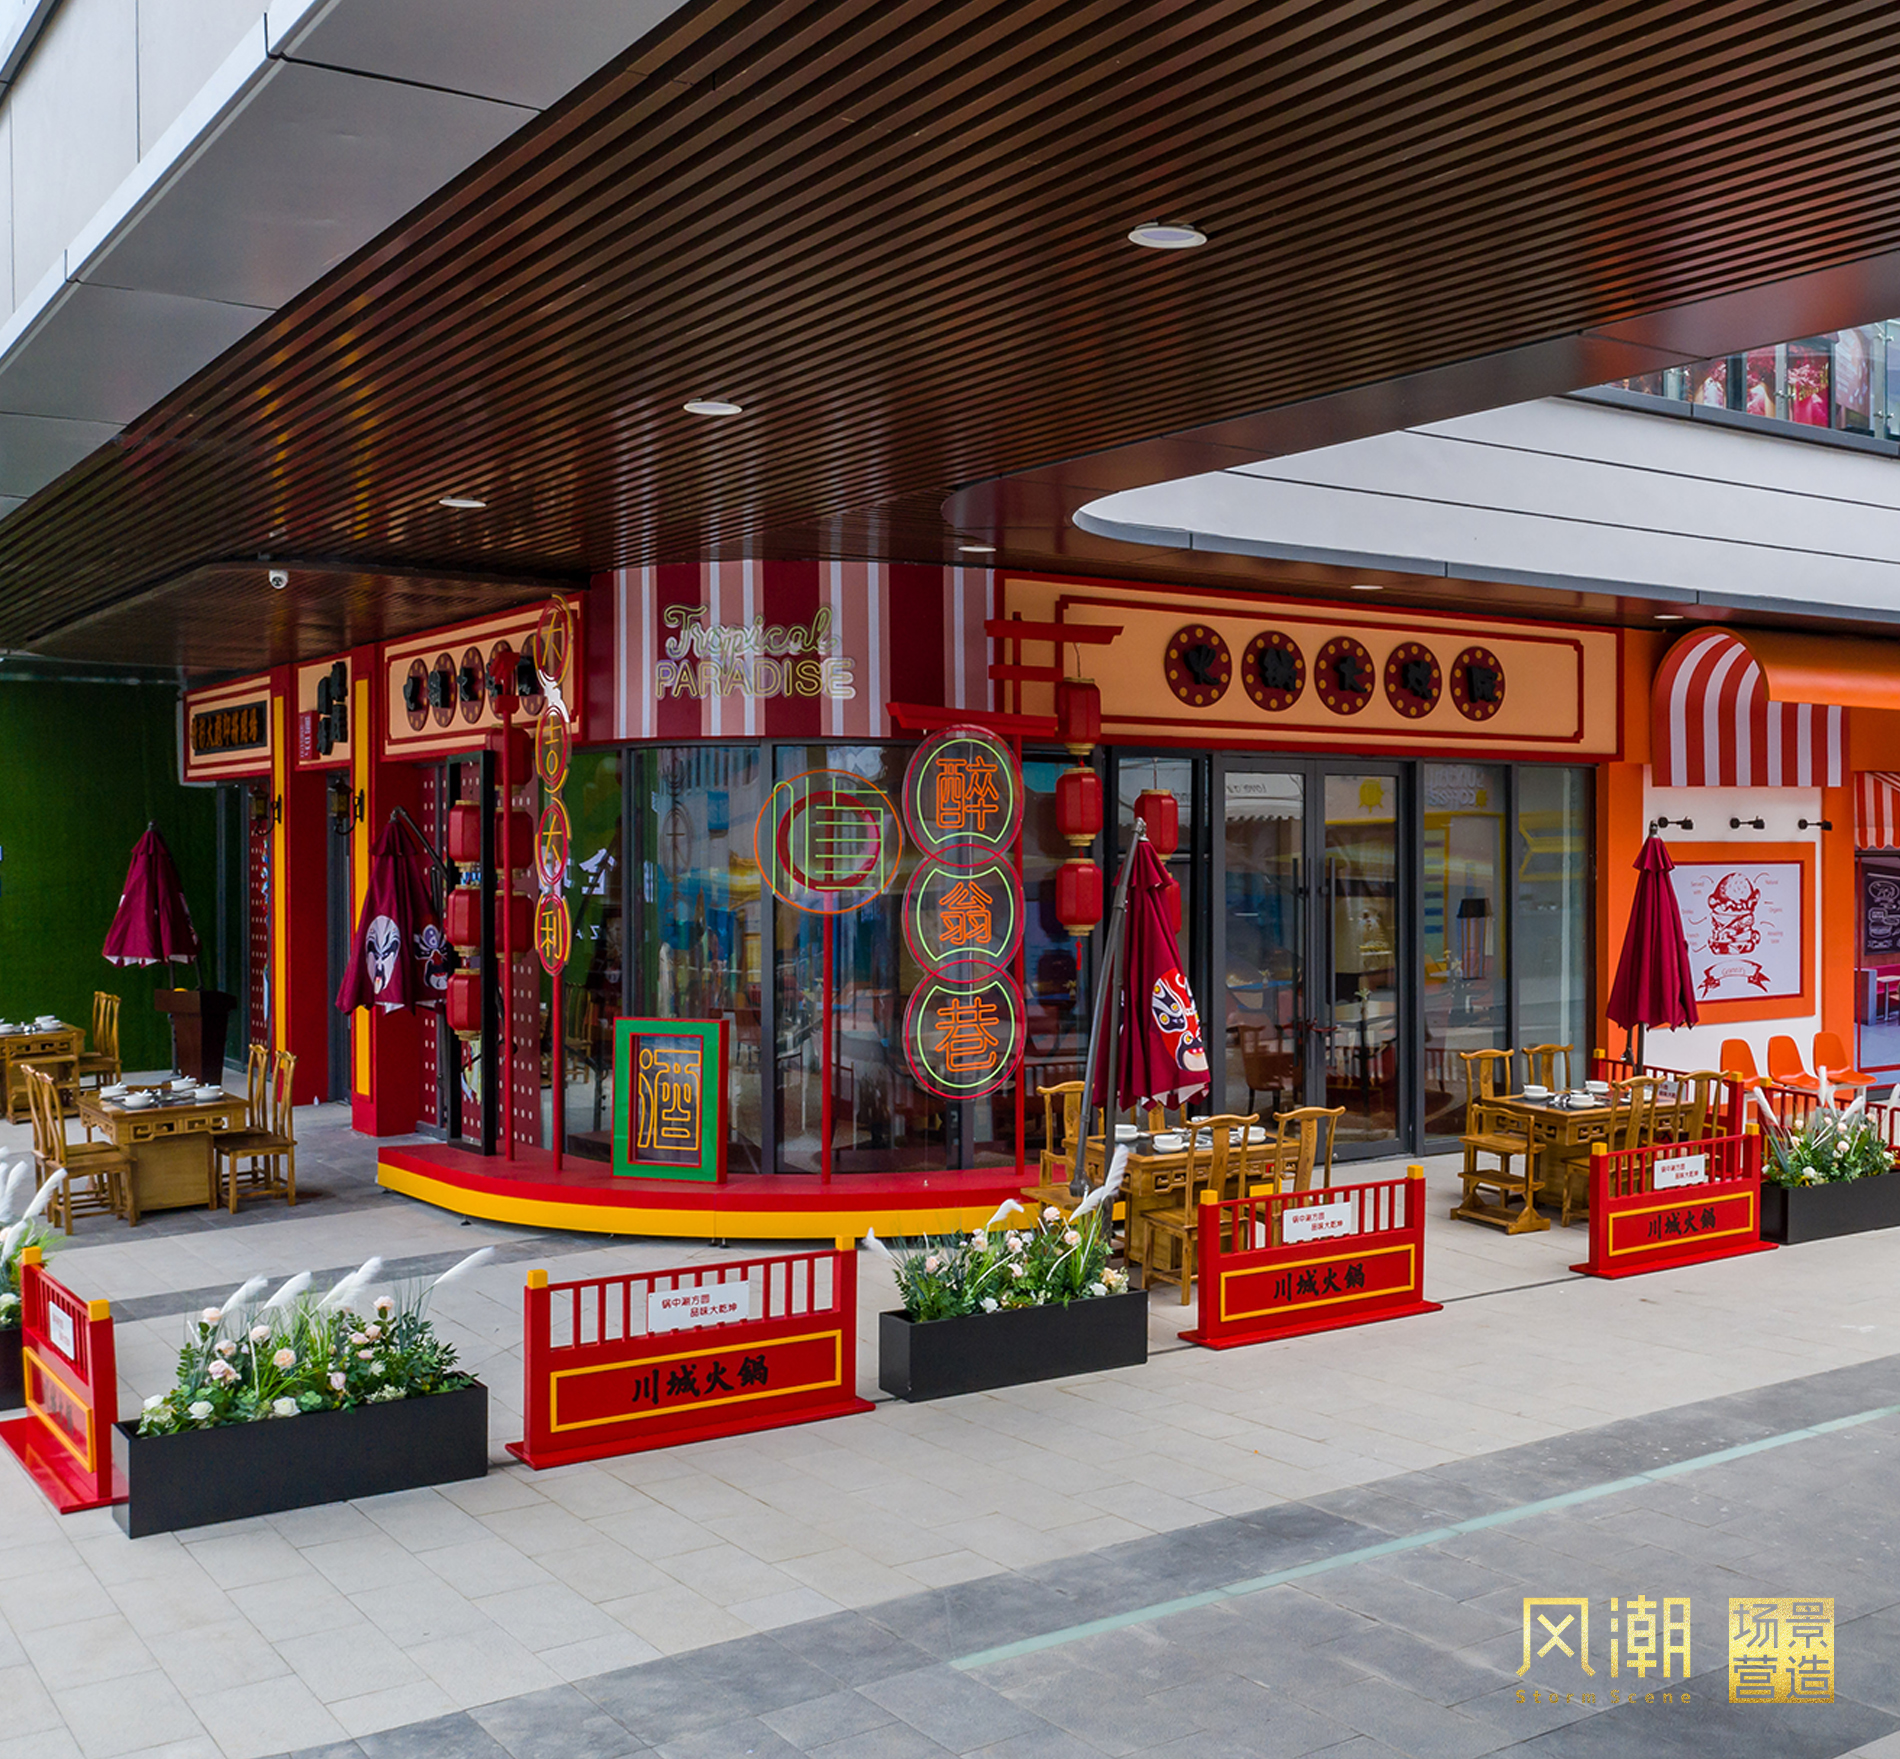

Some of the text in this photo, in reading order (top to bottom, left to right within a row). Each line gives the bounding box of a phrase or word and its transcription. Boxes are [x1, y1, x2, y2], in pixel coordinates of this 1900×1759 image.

[663, 604, 838, 675] Tropical
[655, 657, 856, 699] PARADISE
[540, 611, 564, 959] 大吉大利
[935, 755, 1000, 1073] 醉翁巷
[637, 1048, 702, 1151] 酒
[1273, 1262, 1366, 1302] 川城火鍋
[631, 1353, 770, 1406] 川城火鍋
